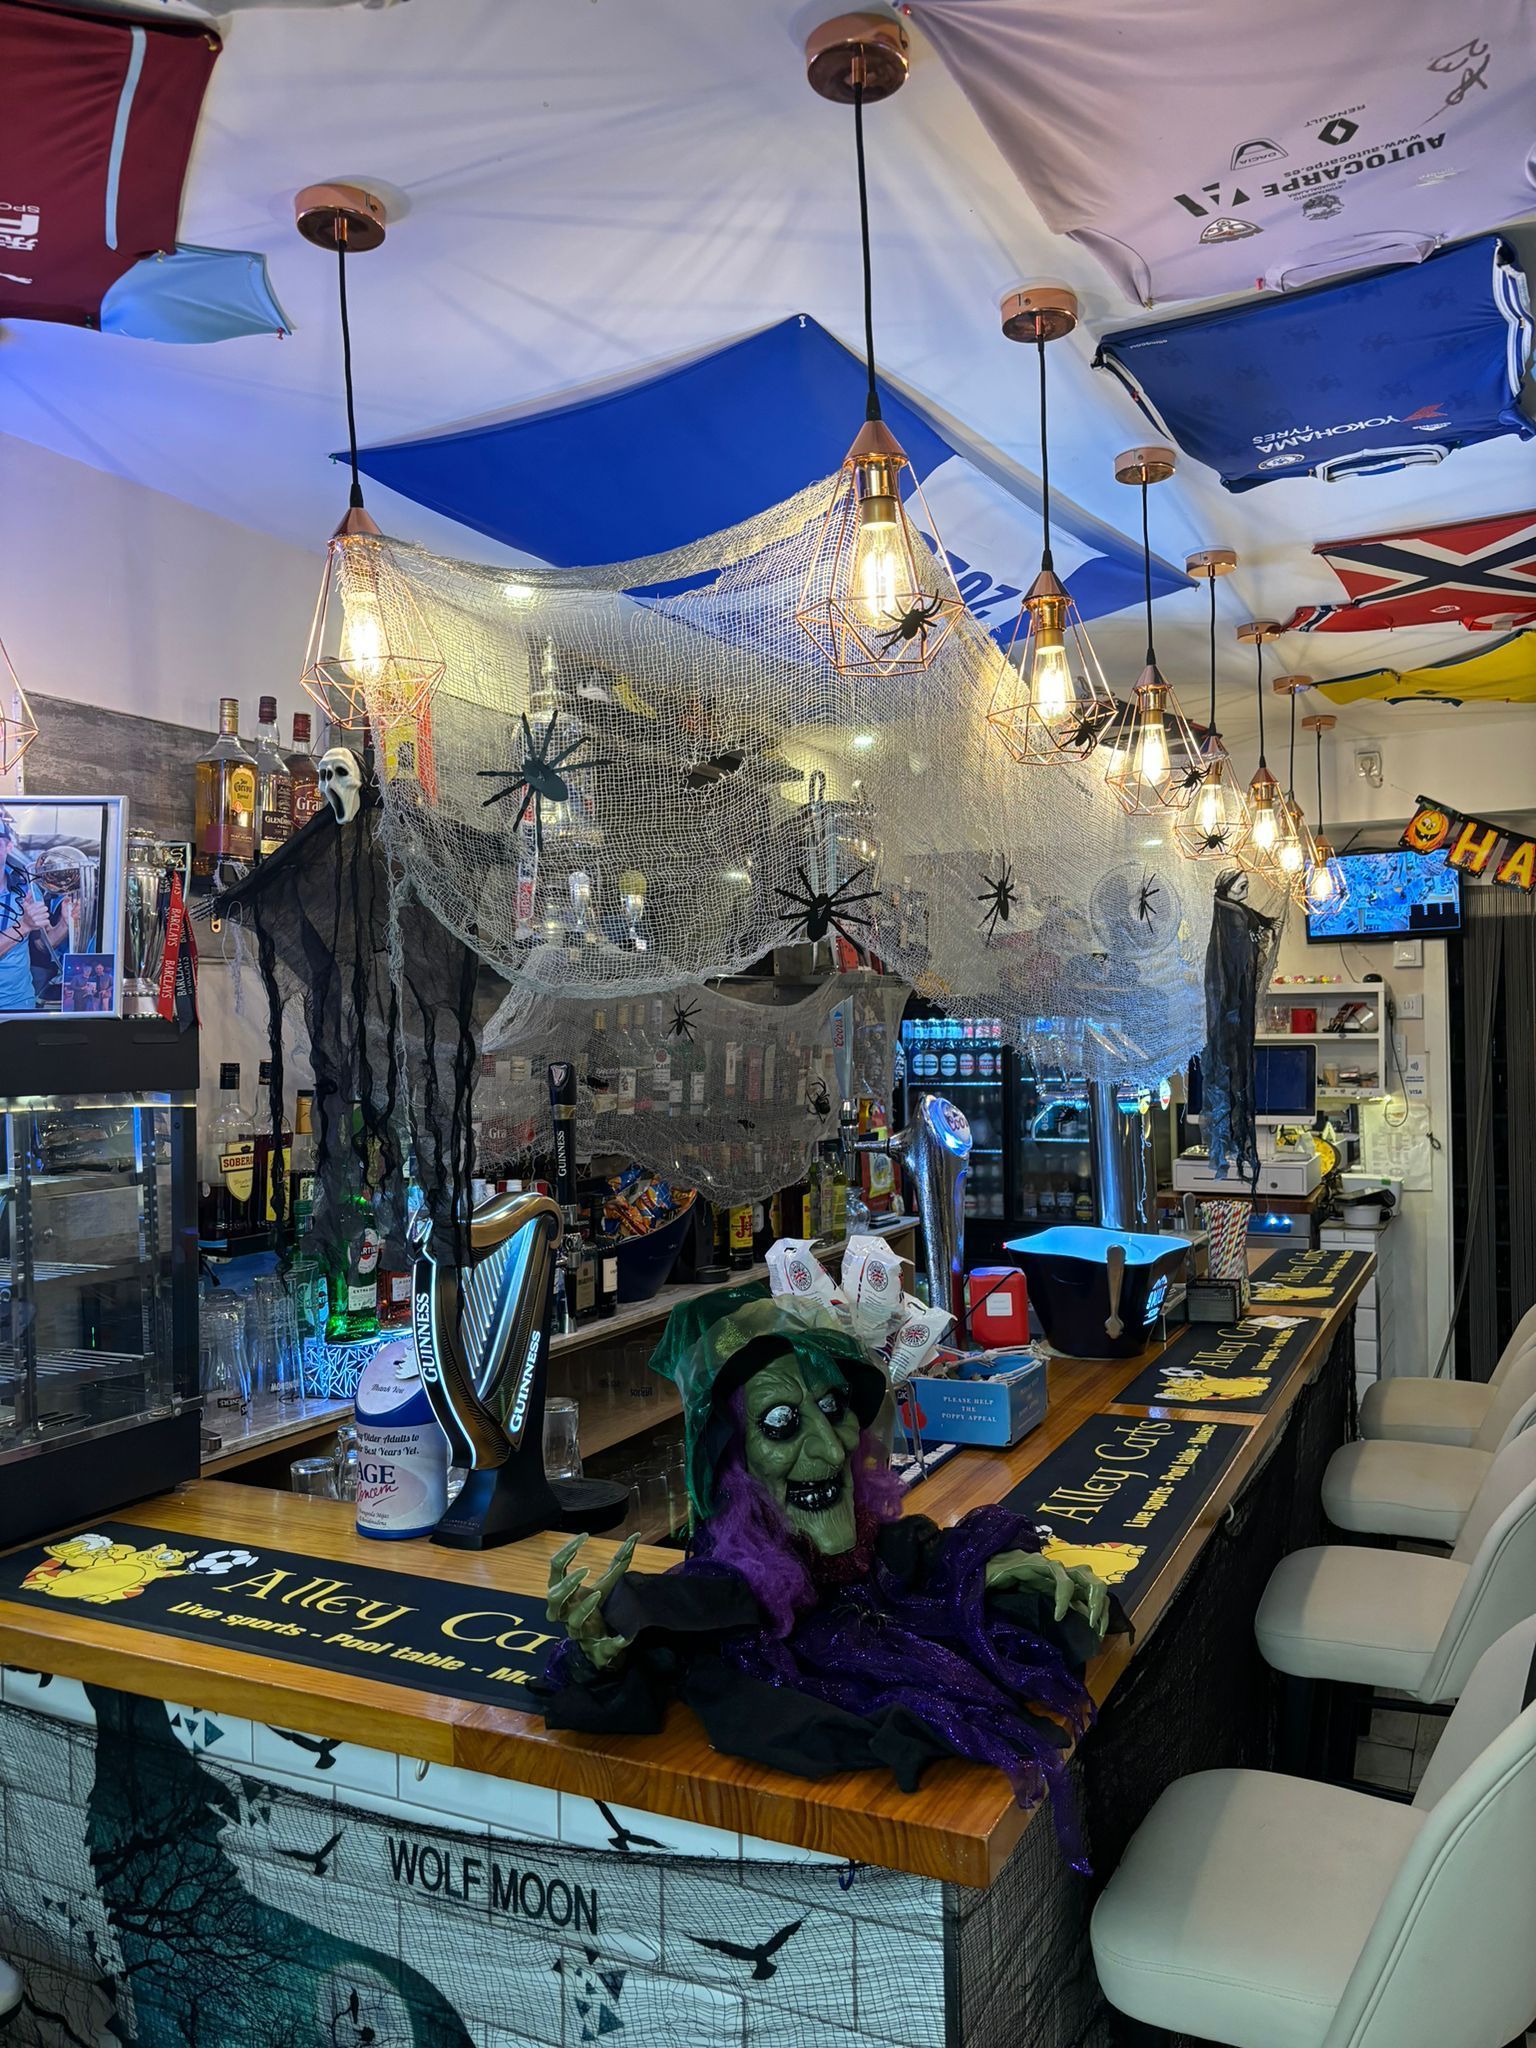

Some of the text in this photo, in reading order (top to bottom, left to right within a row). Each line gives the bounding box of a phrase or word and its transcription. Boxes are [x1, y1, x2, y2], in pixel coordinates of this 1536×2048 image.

[1304, 104, 1367, 128] RENAULT
[1239, 152, 1277, 165] DACIA
[1262, 132, 1446, 197] AUTOCARPE
[1252, 424, 1315, 445] TYRES
[1255, 414, 1405, 453] YOKOHAMA
[168, 907, 182, 946] BARCLAYS
[161, 959, 175, 999] BARCLAYS
[557, 1130, 566, 1177] GUINNESS
[416, 1292, 438, 1383] GUINNESS
[1189, 1340, 1261, 1370] Alley
[509, 1330, 541, 1433] GUINNESS
[943, 1396, 994, 1405] PLEASE HELP
[941, 1412, 997, 1423] POPPY APPEAL
[383, 1434, 410, 1443] Adults
[411, 1433, 419, 1441] to
[1187, 1424, 1218, 1444] Music
[379, 1447, 401, 1456] Years
[1171, 1448, 1202, 1466] table
[1036, 1421, 1175, 1525] Alley Cats
[1159, 1465, 1190, 1481] Pool
[1142, 1486, 1174, 1511] sports
[1123, 1511, 1156, 1528] Live
[212, 1568, 562, 1654] Alley Ca
[167, 1601, 223, 1620] Live
[220, 1612, 306, 1637] sports
[323, 1632, 393, 1655] Pool
[389, 1645, 467, 1672] table
[387, 1836, 598, 1935] WOLF MOON
